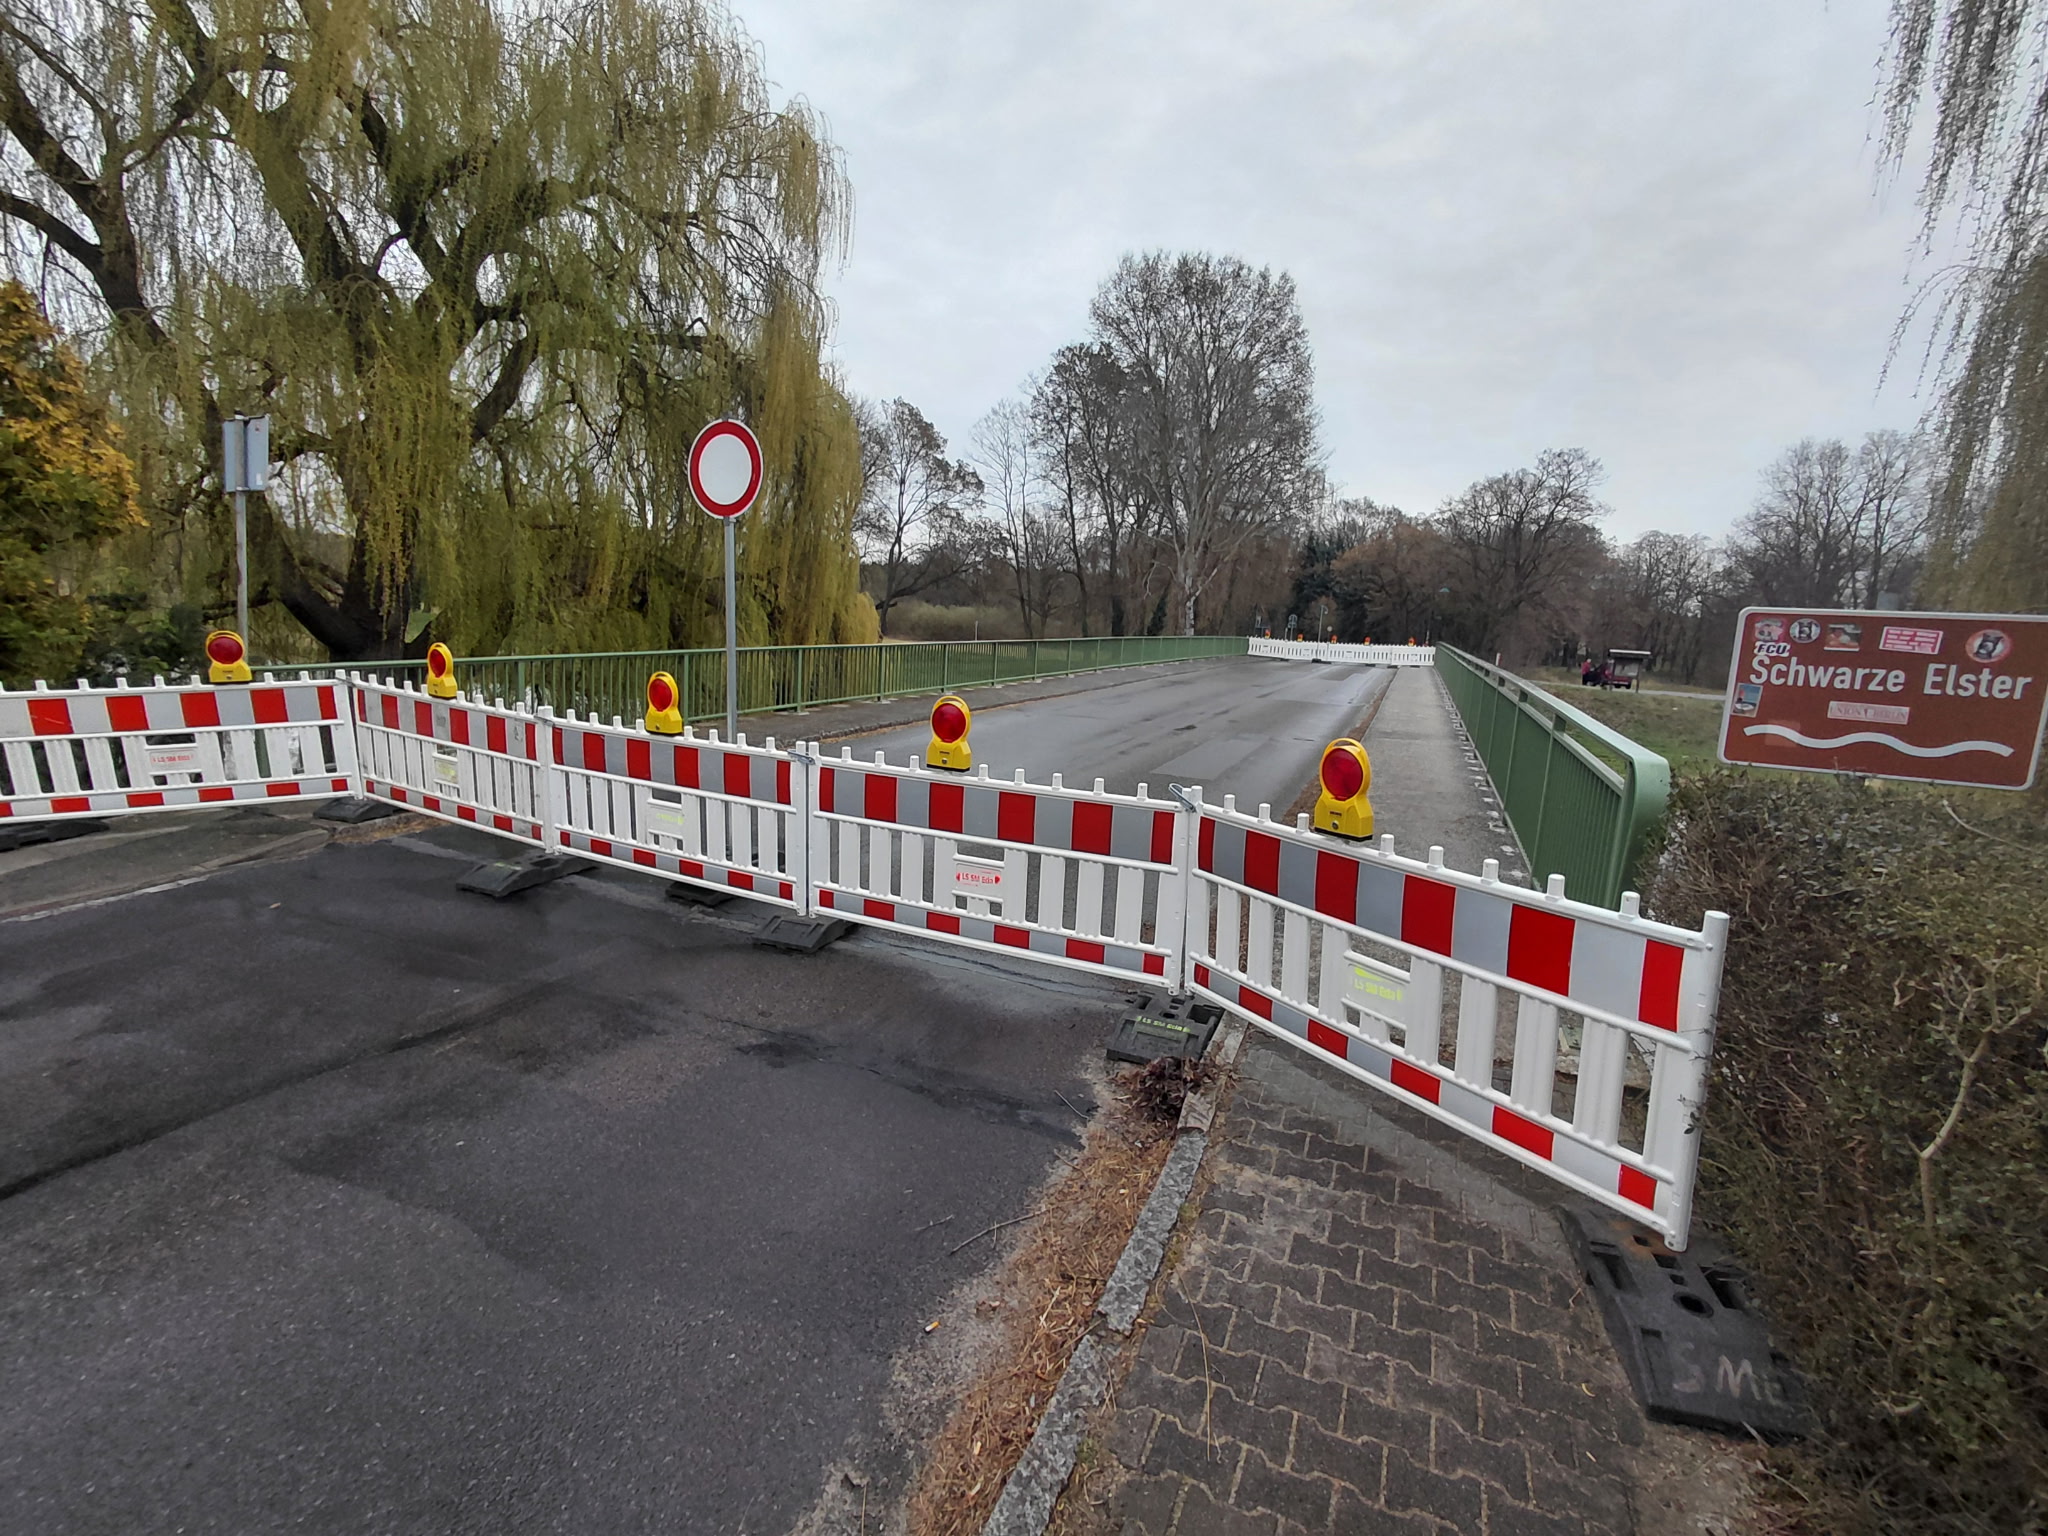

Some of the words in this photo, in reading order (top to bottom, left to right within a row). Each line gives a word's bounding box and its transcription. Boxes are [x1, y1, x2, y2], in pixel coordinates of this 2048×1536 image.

[1757, 643, 1787, 655] FCU
[1749, 655, 1906, 693] Schwarze
[1923, 663, 2032, 700] Elster
